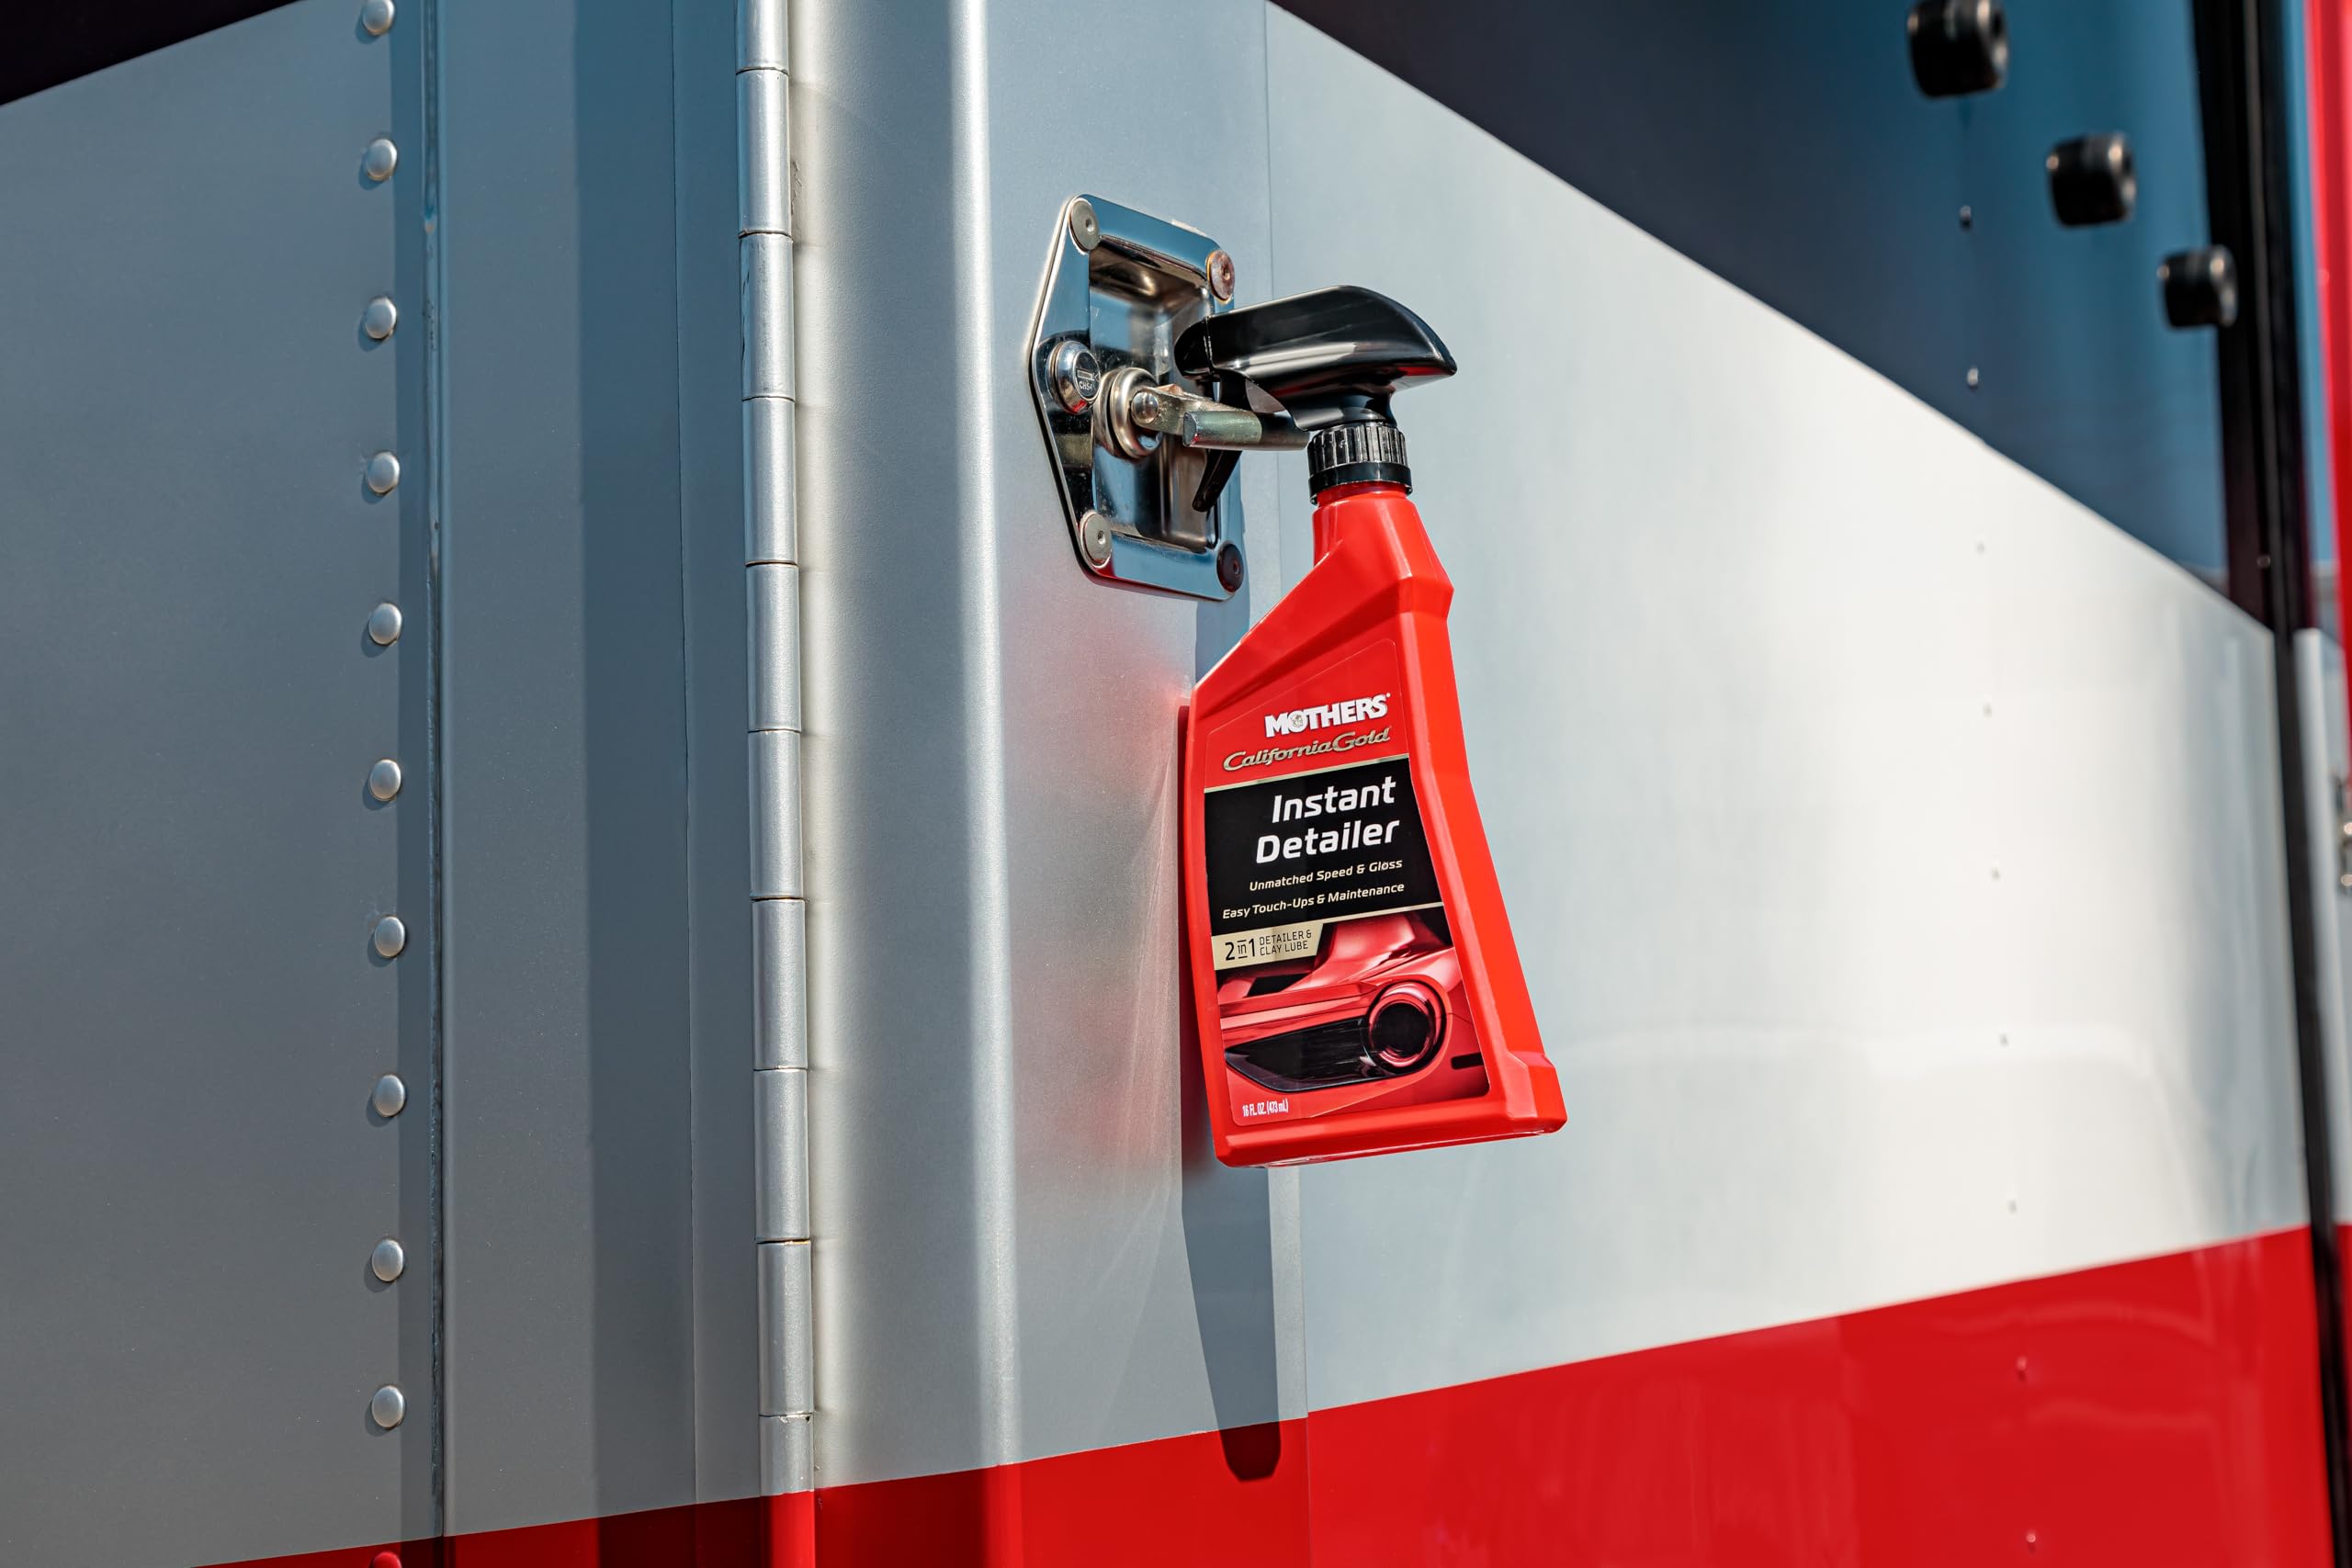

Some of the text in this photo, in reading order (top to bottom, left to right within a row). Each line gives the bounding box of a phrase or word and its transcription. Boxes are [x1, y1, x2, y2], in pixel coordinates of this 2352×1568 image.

[1264, 694, 1388, 738] MOTHERS
[1272, 775, 1396, 824] Instant
[1255, 819, 1400, 863] Detailer
[1250, 860, 1403, 891] Unmatched Speed & Gloss
[1222, 884, 1405, 919] Easy Touch-Ups & Maintenance
[1259, 929, 1312, 946] DETAILER &
[1260, 940, 1309, 956] CLAY LUBE
[1242, 1104, 1250, 1117] 16
